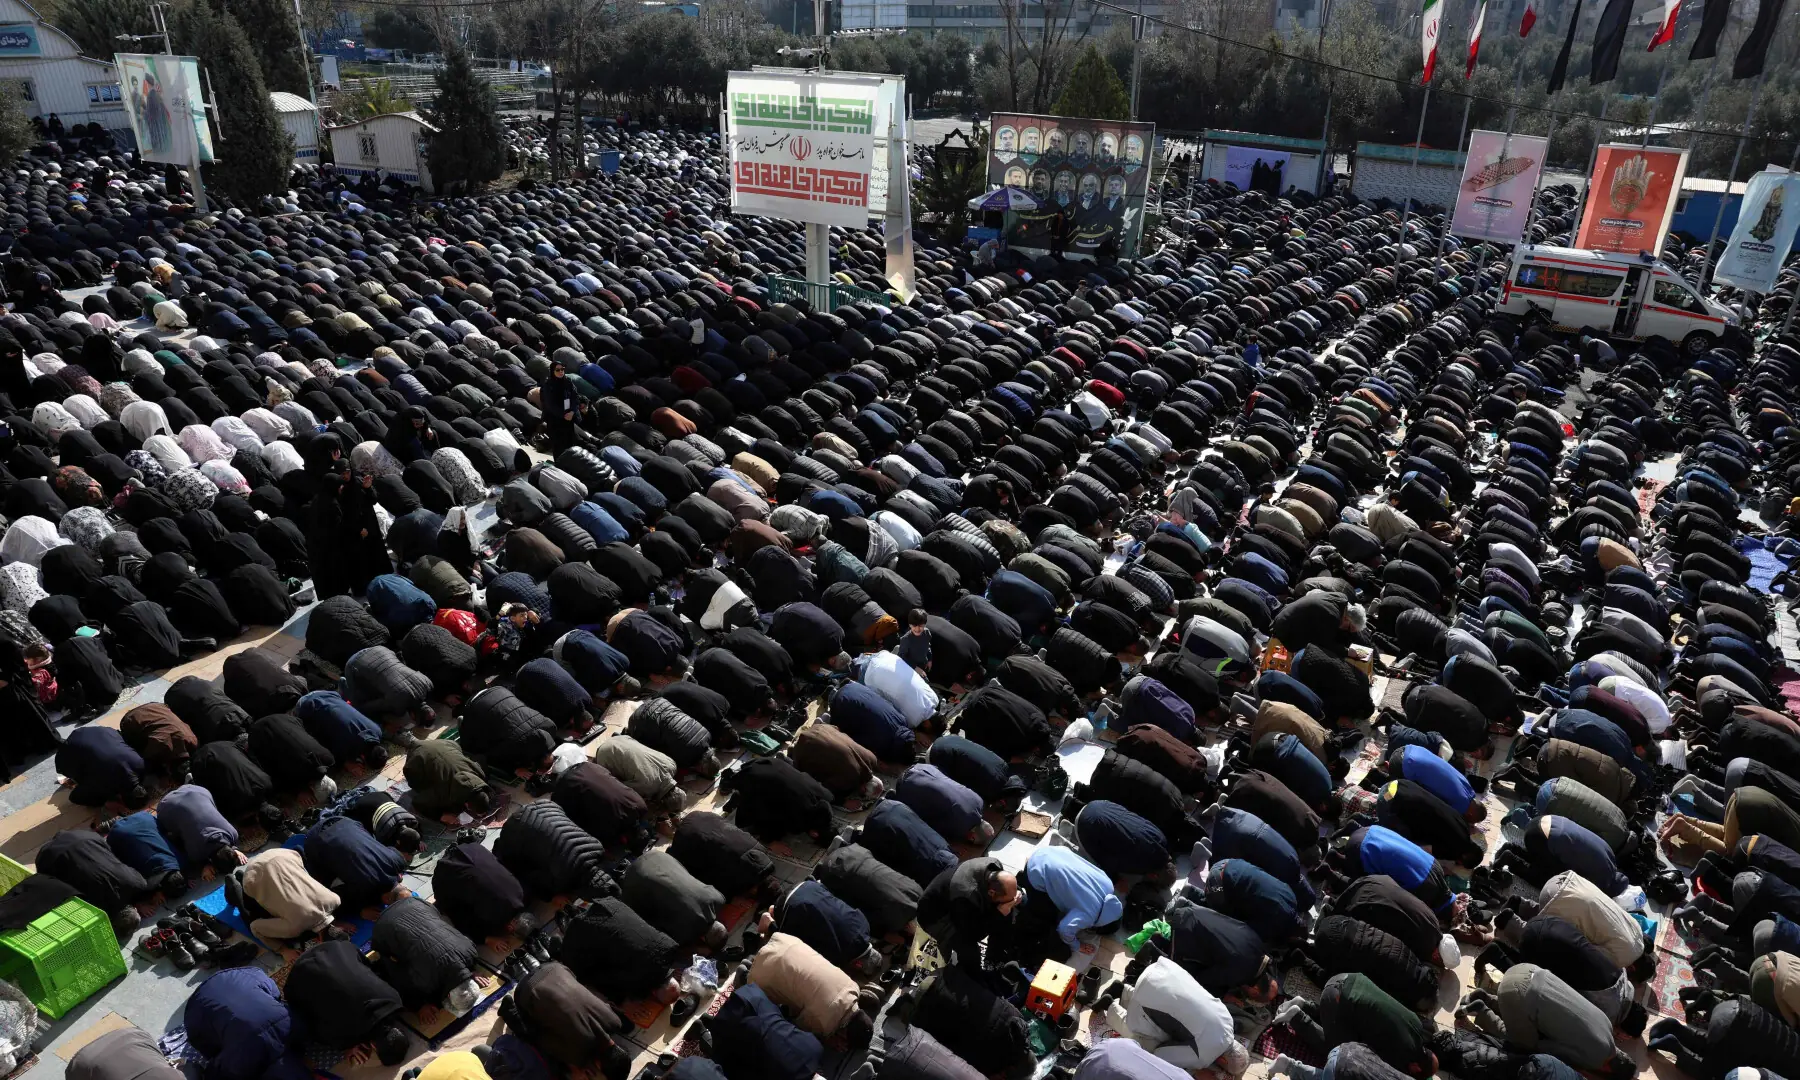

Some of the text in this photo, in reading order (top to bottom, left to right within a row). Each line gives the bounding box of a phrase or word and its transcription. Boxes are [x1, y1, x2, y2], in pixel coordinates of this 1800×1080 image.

[819, 97, 874, 134] لبیک
[734, 137, 746, 153] پسر
[757, 129, 790, 154] گوش
[815, 144, 823, 160] پدر
[820, 168, 869, 207] لبیک
